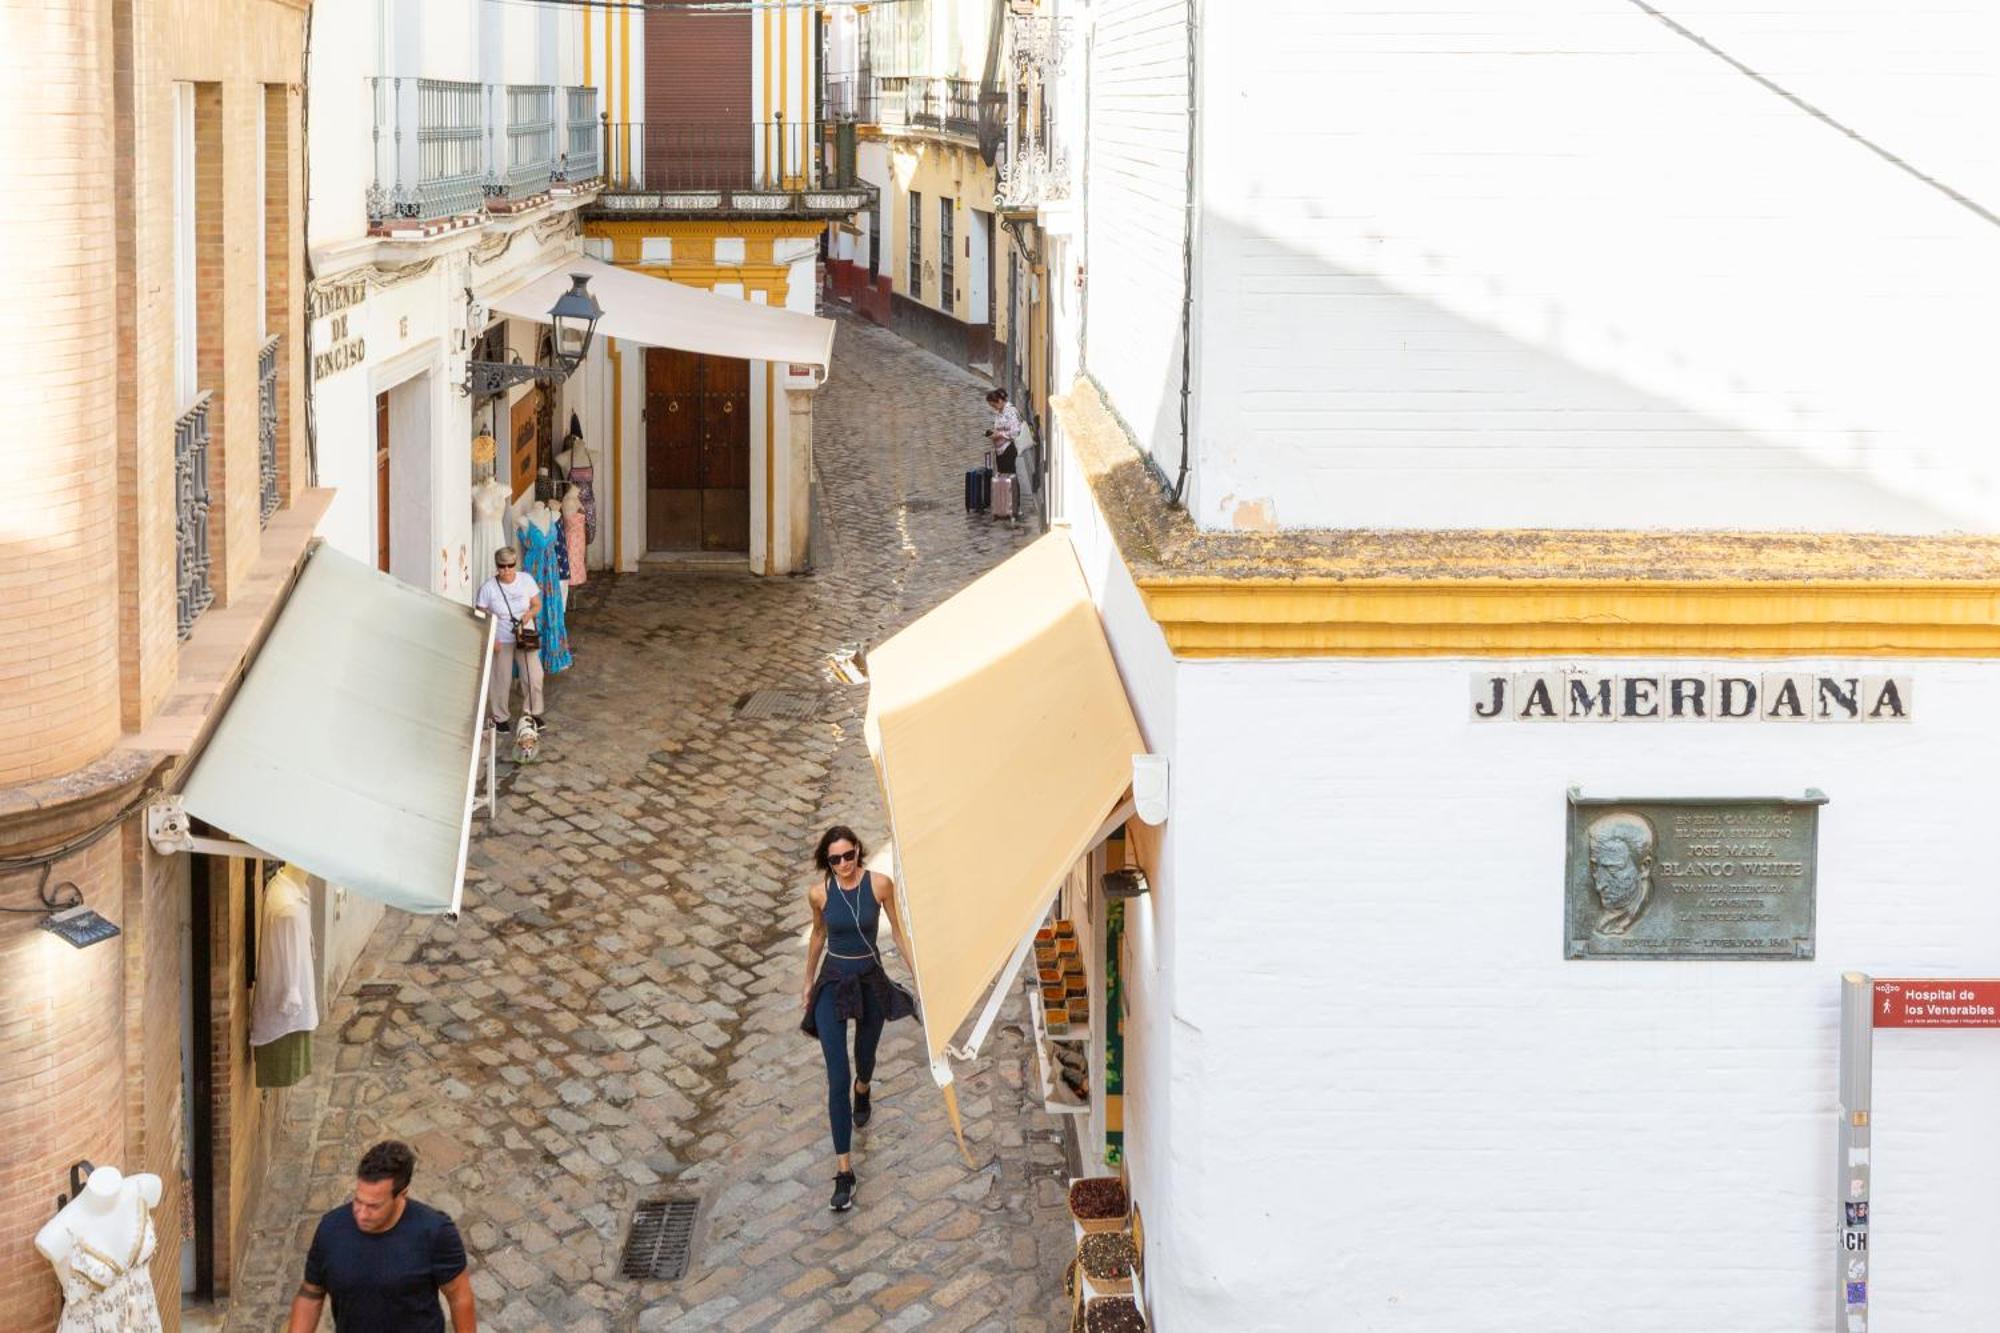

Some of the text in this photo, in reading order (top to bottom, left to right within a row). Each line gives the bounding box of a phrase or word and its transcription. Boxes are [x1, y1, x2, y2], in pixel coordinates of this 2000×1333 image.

[331, 314, 349, 342] DE
[315, 337, 365, 380] ENCISO
[1475, 677, 1907, 719] JAMERDANA
[1687, 840, 1777, 857] JOSÉ MARÍA
[1660, 862, 1804, 877] BLANCO WHITE
[1905, 989, 1975, 1002] Hospital de
[1905, 1004, 1995, 1015] los Venerables
